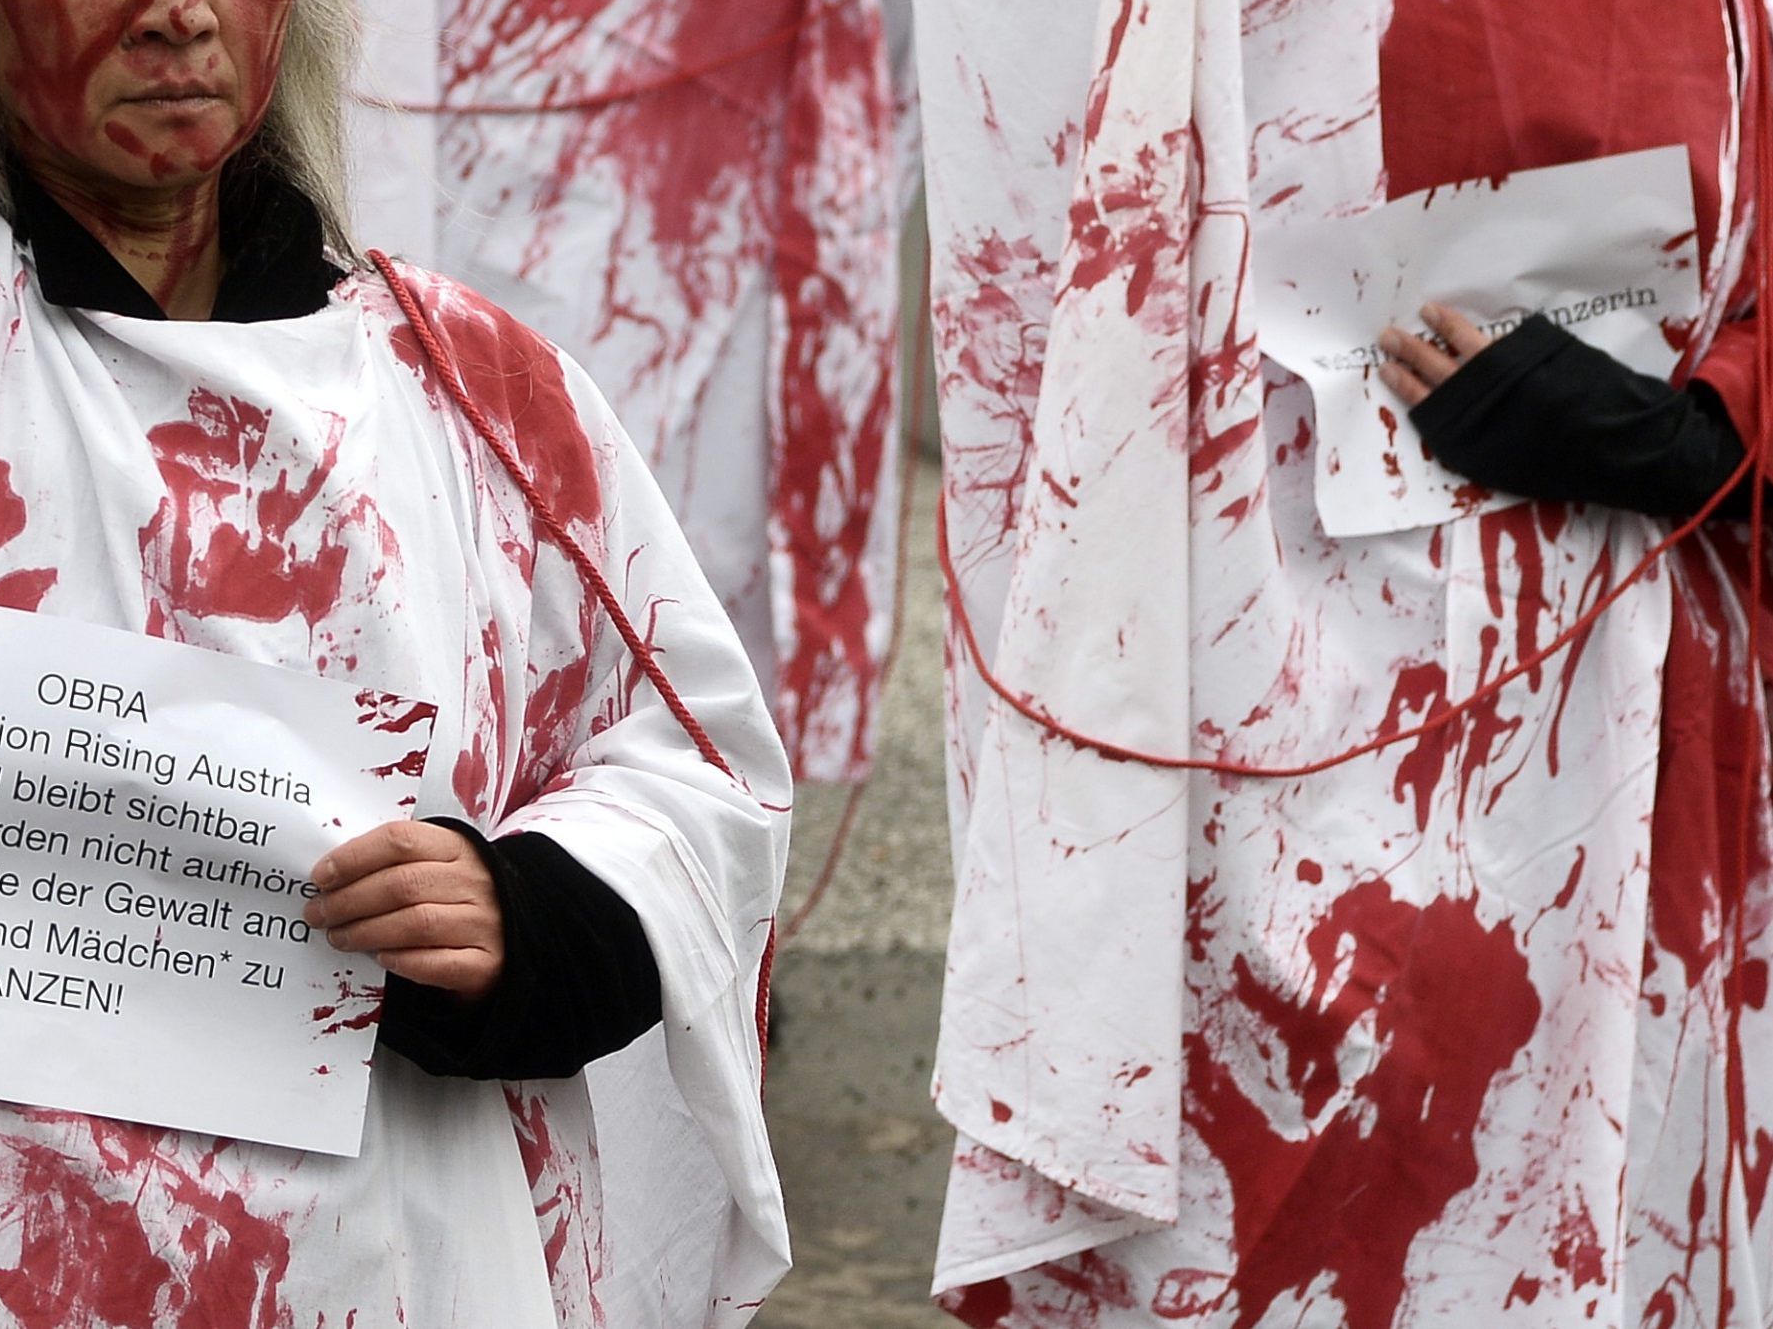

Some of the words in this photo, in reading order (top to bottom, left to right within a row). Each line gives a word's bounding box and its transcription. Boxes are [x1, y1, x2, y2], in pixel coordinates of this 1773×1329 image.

[37, 673, 148, 724] OBRA
[64, 727, 177, 786] Rising
[186, 753, 312, 807] Austria
[12, 769, 117, 816] bleibt
[126, 794, 277, 847] sichtbar
[81, 833, 173, 873] nicht
[182, 857, 321, 899] aufhöre
[32, 872, 94, 908] der
[104, 881, 233, 931] Gewalt
[240, 961, 284, 990] zu
